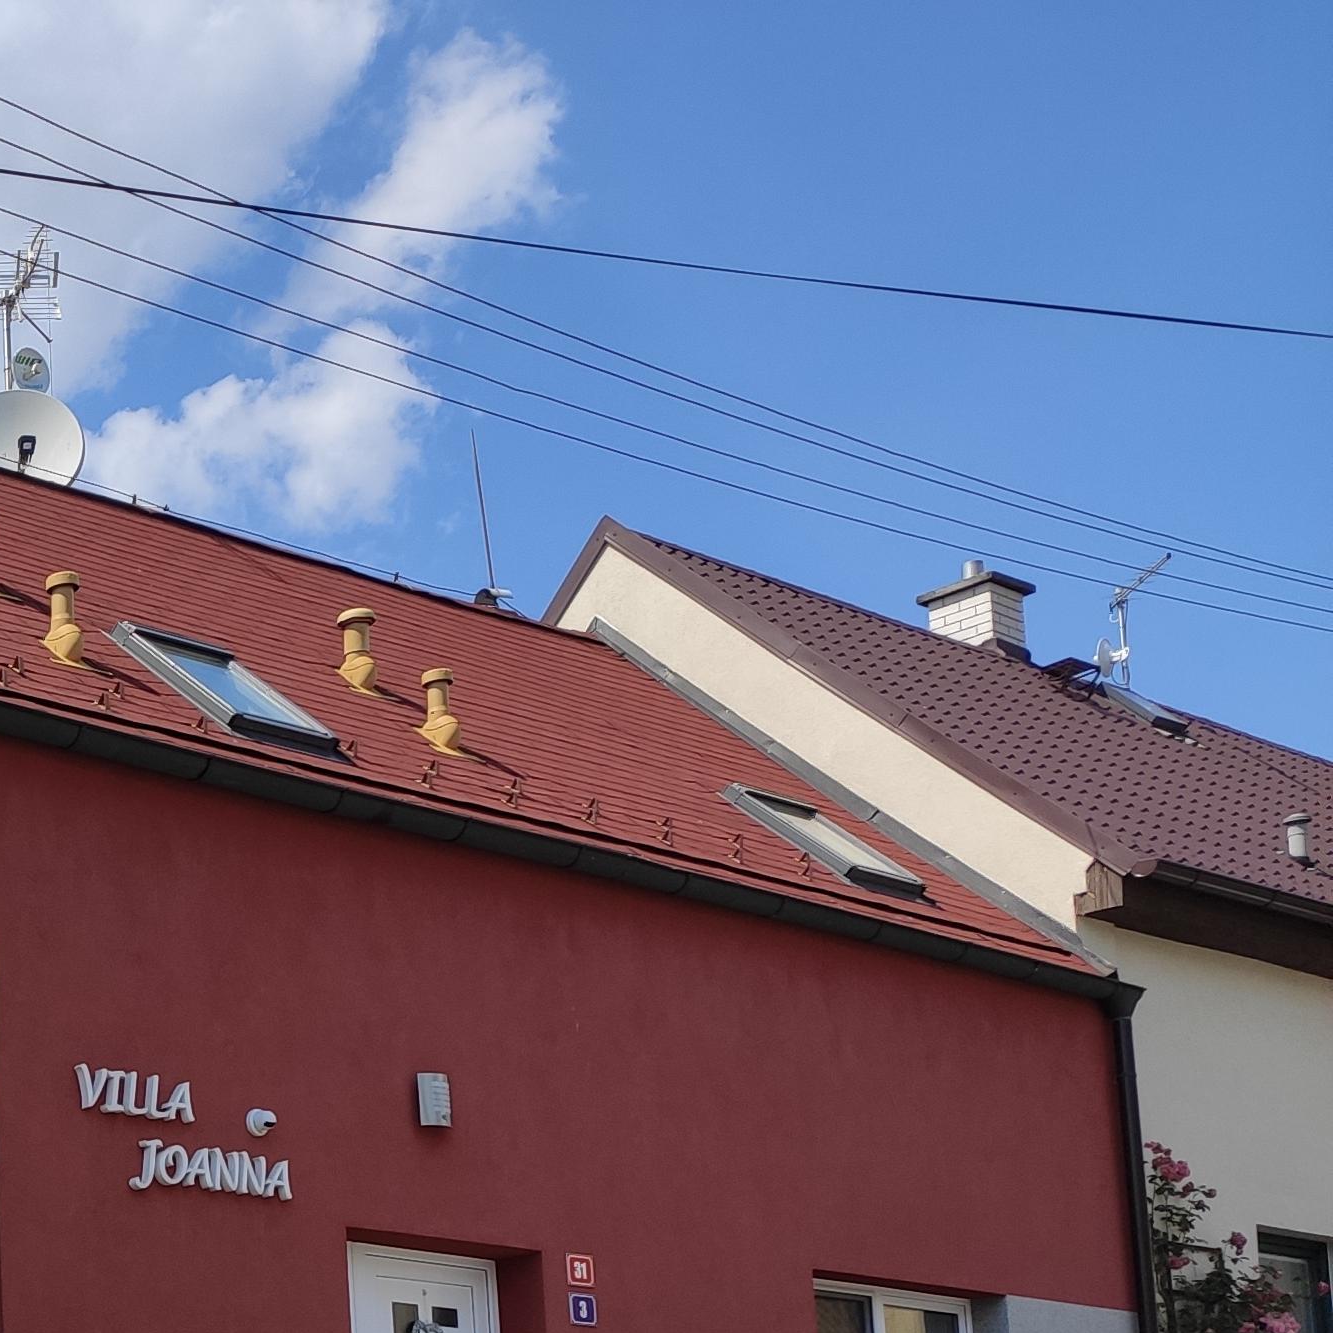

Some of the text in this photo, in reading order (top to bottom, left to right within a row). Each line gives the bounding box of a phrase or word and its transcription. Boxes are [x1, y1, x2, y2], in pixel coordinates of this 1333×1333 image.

[74, 1063, 196, 1124] VILLA
[129, 1139, 293, 1201] JOANNA
[573, 1261, 588, 1280] 31
[579, 1300, 588, 1319] 3
